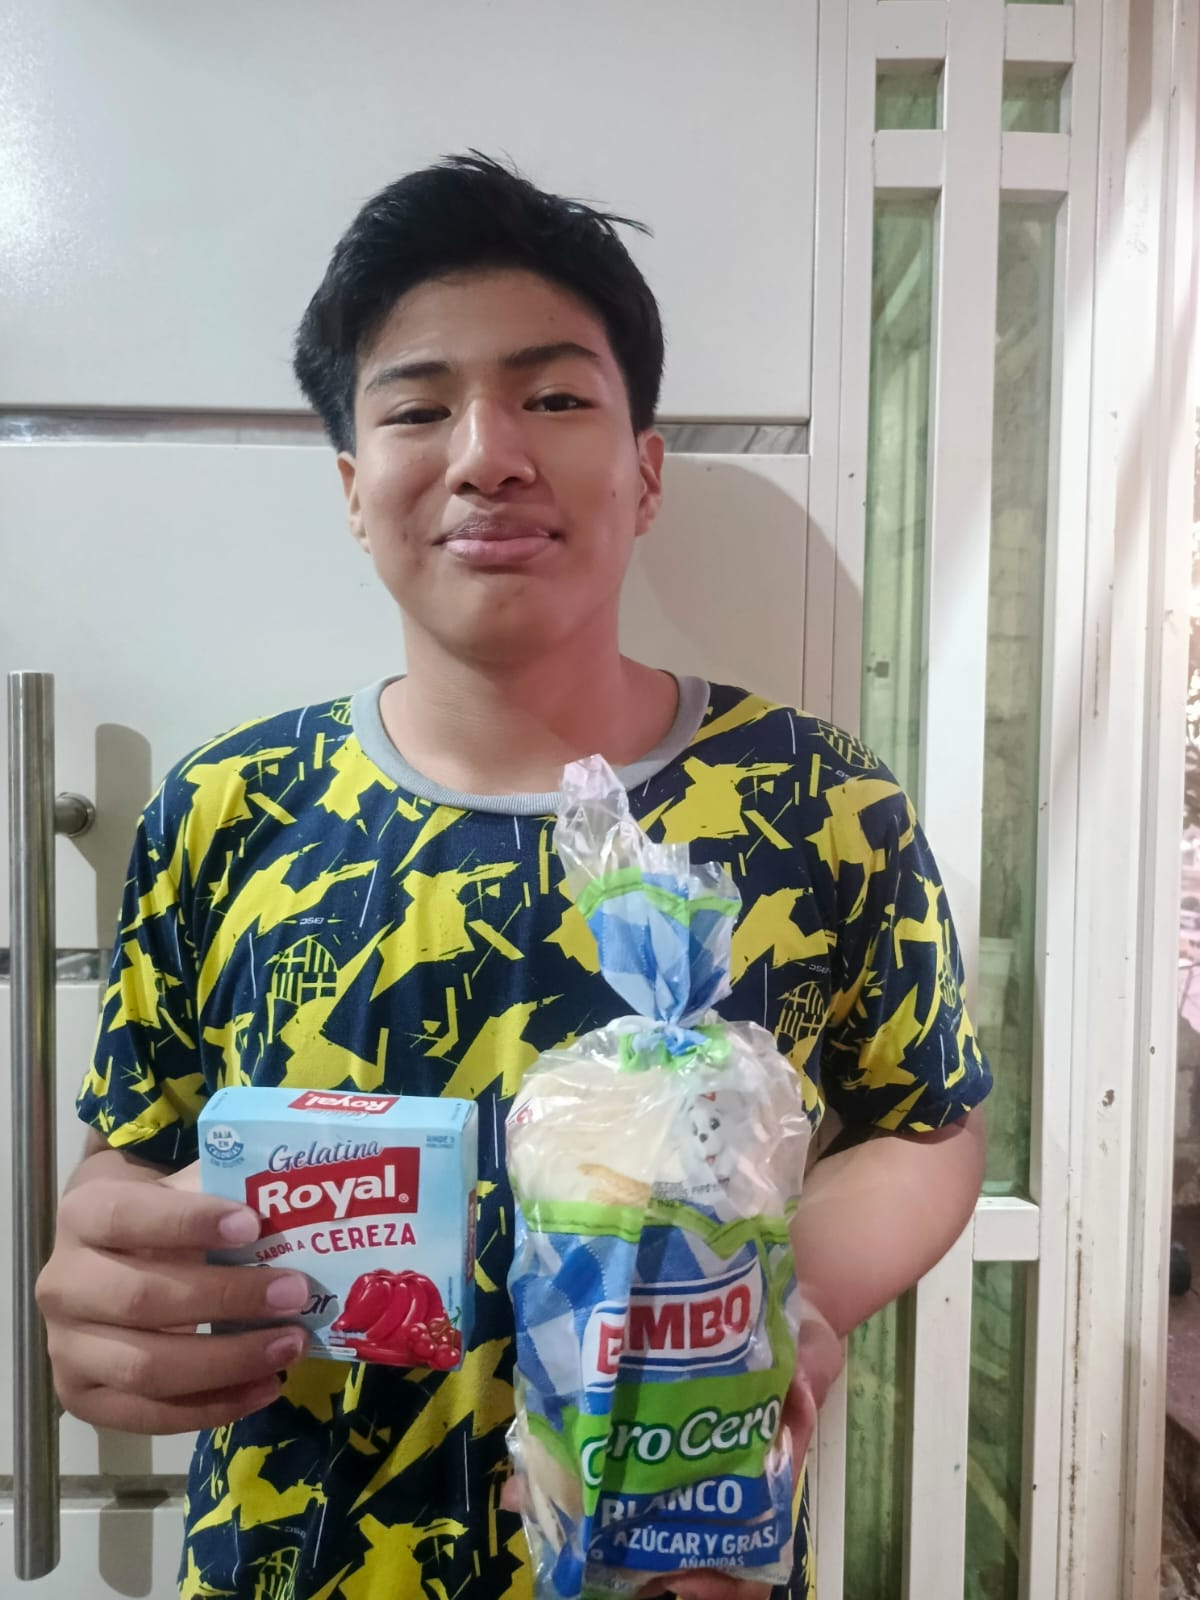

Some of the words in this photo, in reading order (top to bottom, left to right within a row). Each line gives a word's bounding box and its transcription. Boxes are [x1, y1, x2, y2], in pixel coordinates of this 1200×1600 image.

[304, 1094, 390, 1111] Royal
[213, 1131, 232, 1139] BAJA
[268, 1139, 383, 1173] Gelatina
[257, 1164, 396, 1219] Royal
[256, 1242, 294, 1262] SABOR
[297, 1240, 306, 1251] A
[311, 1223, 417, 1254] CEREZA
[597, 1284, 751, 1375] BMBO
[583, 1424, 671, 1485] Cro
[680, 1399, 781, 1456] Cero
[613, 1525, 700, 1556] AZÚCAR
[704, 1534, 719, 1555] Y
[722, 1525, 779, 1555] GRAS
